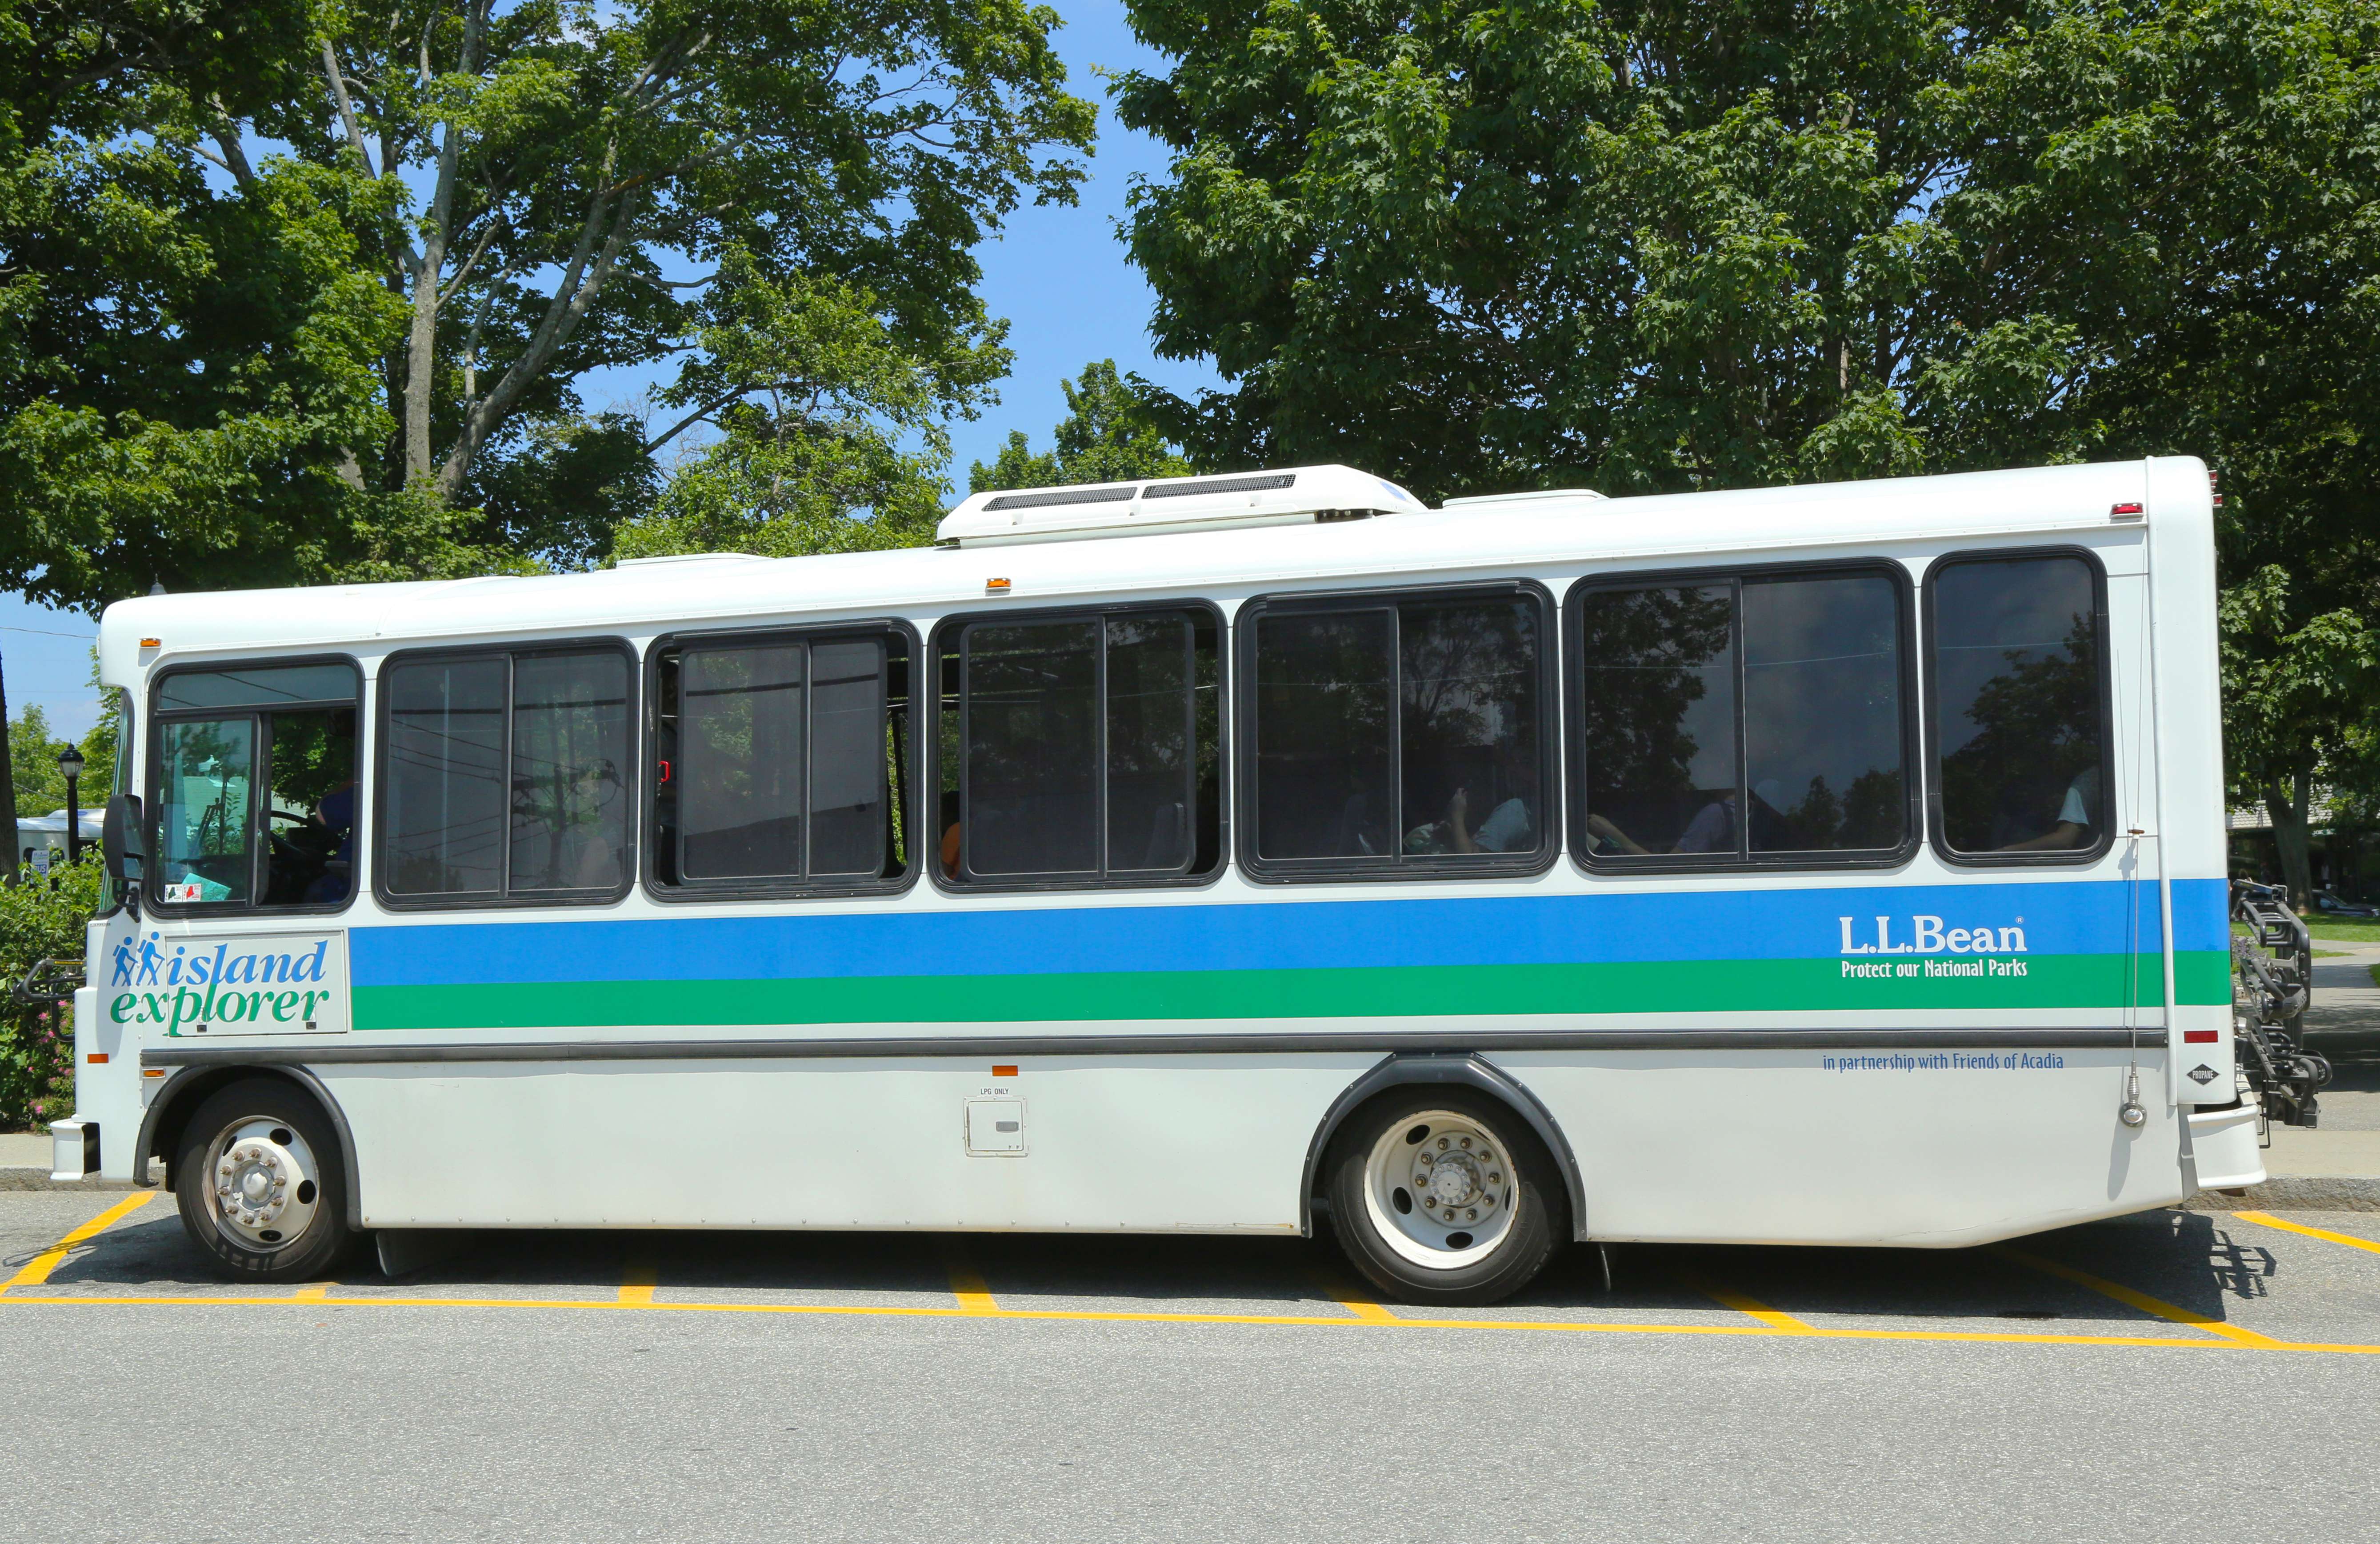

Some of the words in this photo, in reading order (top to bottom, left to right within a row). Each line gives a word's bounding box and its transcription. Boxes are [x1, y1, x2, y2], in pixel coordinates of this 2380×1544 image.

[167, 940, 328, 986] island
[1841, 960, 1892, 978] Protect
[1896, 964, 1920, 977] our
[1924, 959, 1984, 977] National
[1988, 958, 2028, 976] Parks
[110, 983, 330, 1036] explorer
[1823, 1055, 1836, 1070] in
[1839, 1053, 1915, 1073] partnership
[1918, 1053, 1948, 1069] with
[1952, 1052, 2000, 1069] Friends
[2003, 1052, 2016, 1070] of
[2021, 1052, 2064, 1069] Acadia
[2192, 1070, 2214, 1079] PROPANE
